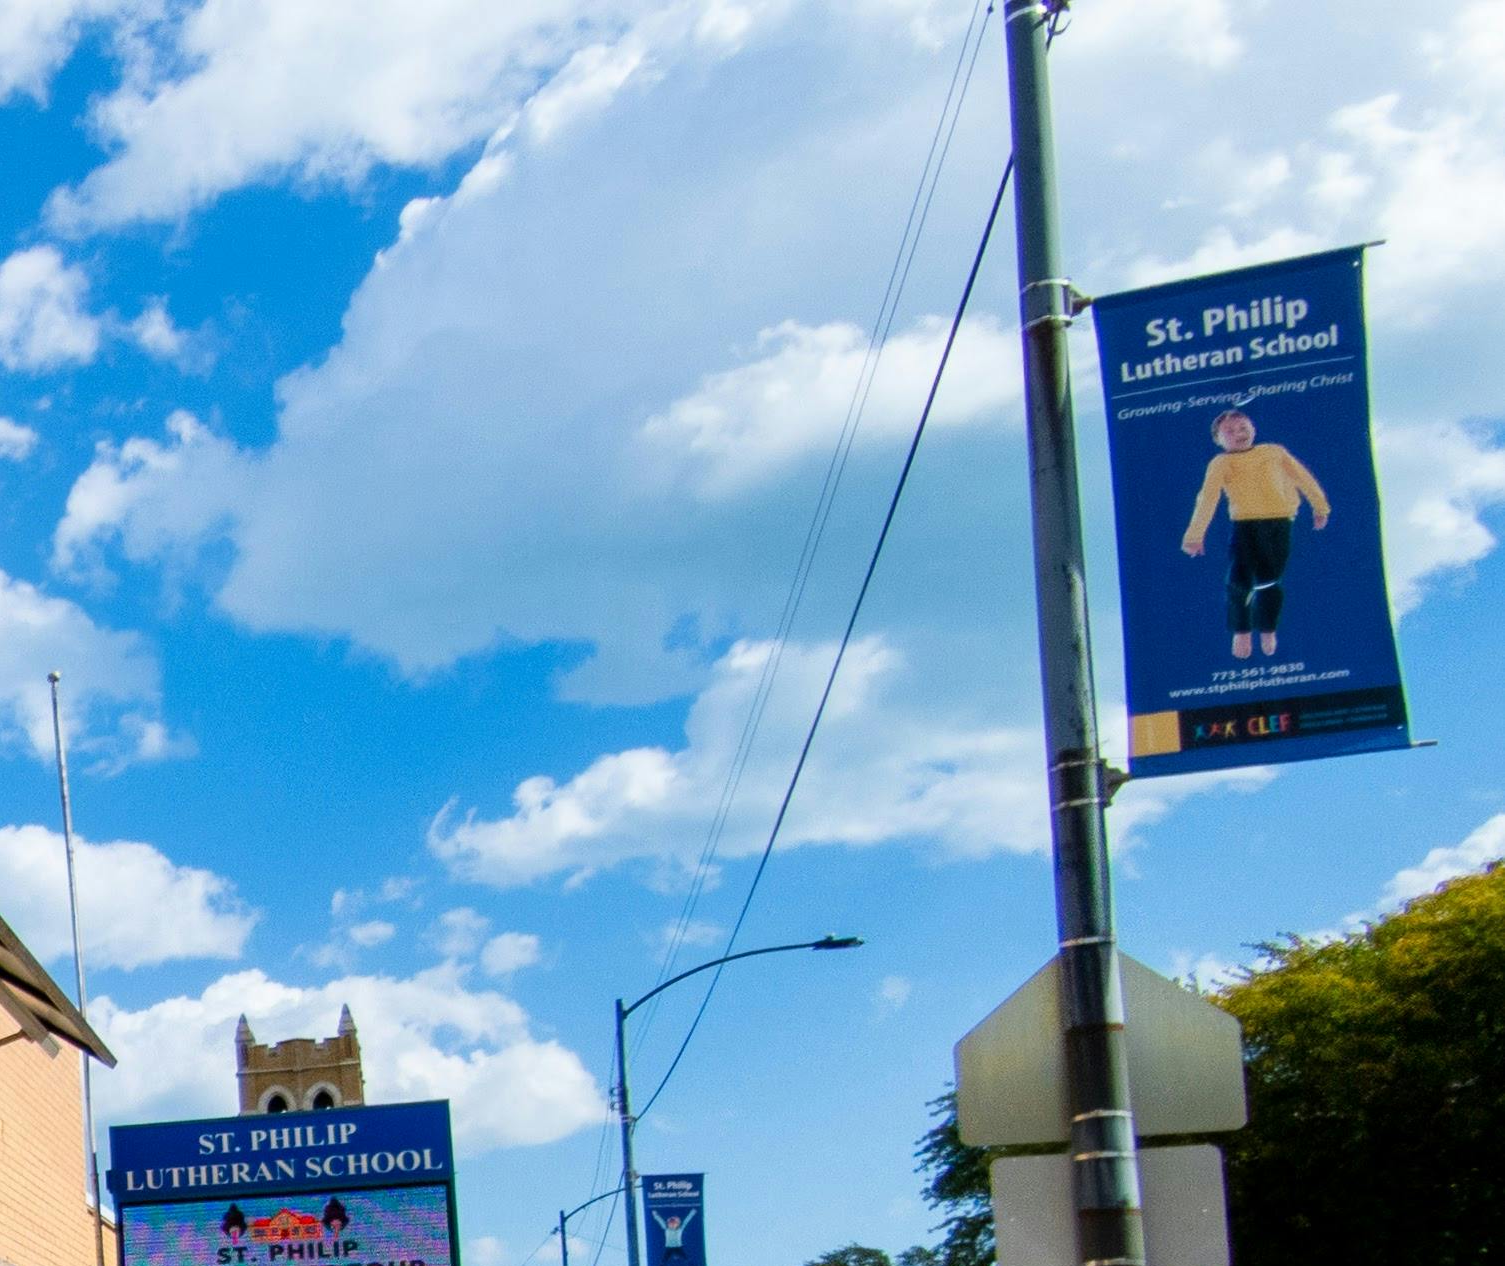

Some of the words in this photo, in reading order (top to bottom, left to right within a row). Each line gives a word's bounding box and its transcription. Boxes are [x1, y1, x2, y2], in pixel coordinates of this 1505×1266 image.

[1145, 317, 1194, 347] St.
[1203, 295, 1308, 337] Philip
[1120, 345, 1243, 383] Lutheran
[1249, 323, 1339, 360] School
[1309, 371, 1354, 388] Christ
[1168, 667, 1350, 698] www.stphiliplutheran.com
[199, 1132, 241, 1155] ST.
[250, 1122, 357, 1151] PHILIP
[126, 1158, 295, 1191] LUTHERAN
[305, 1148, 443, 1179] SCHOOL
[217, 1246, 256, 1265] ST.
[269, 1240, 359, 1262] PHILIP
